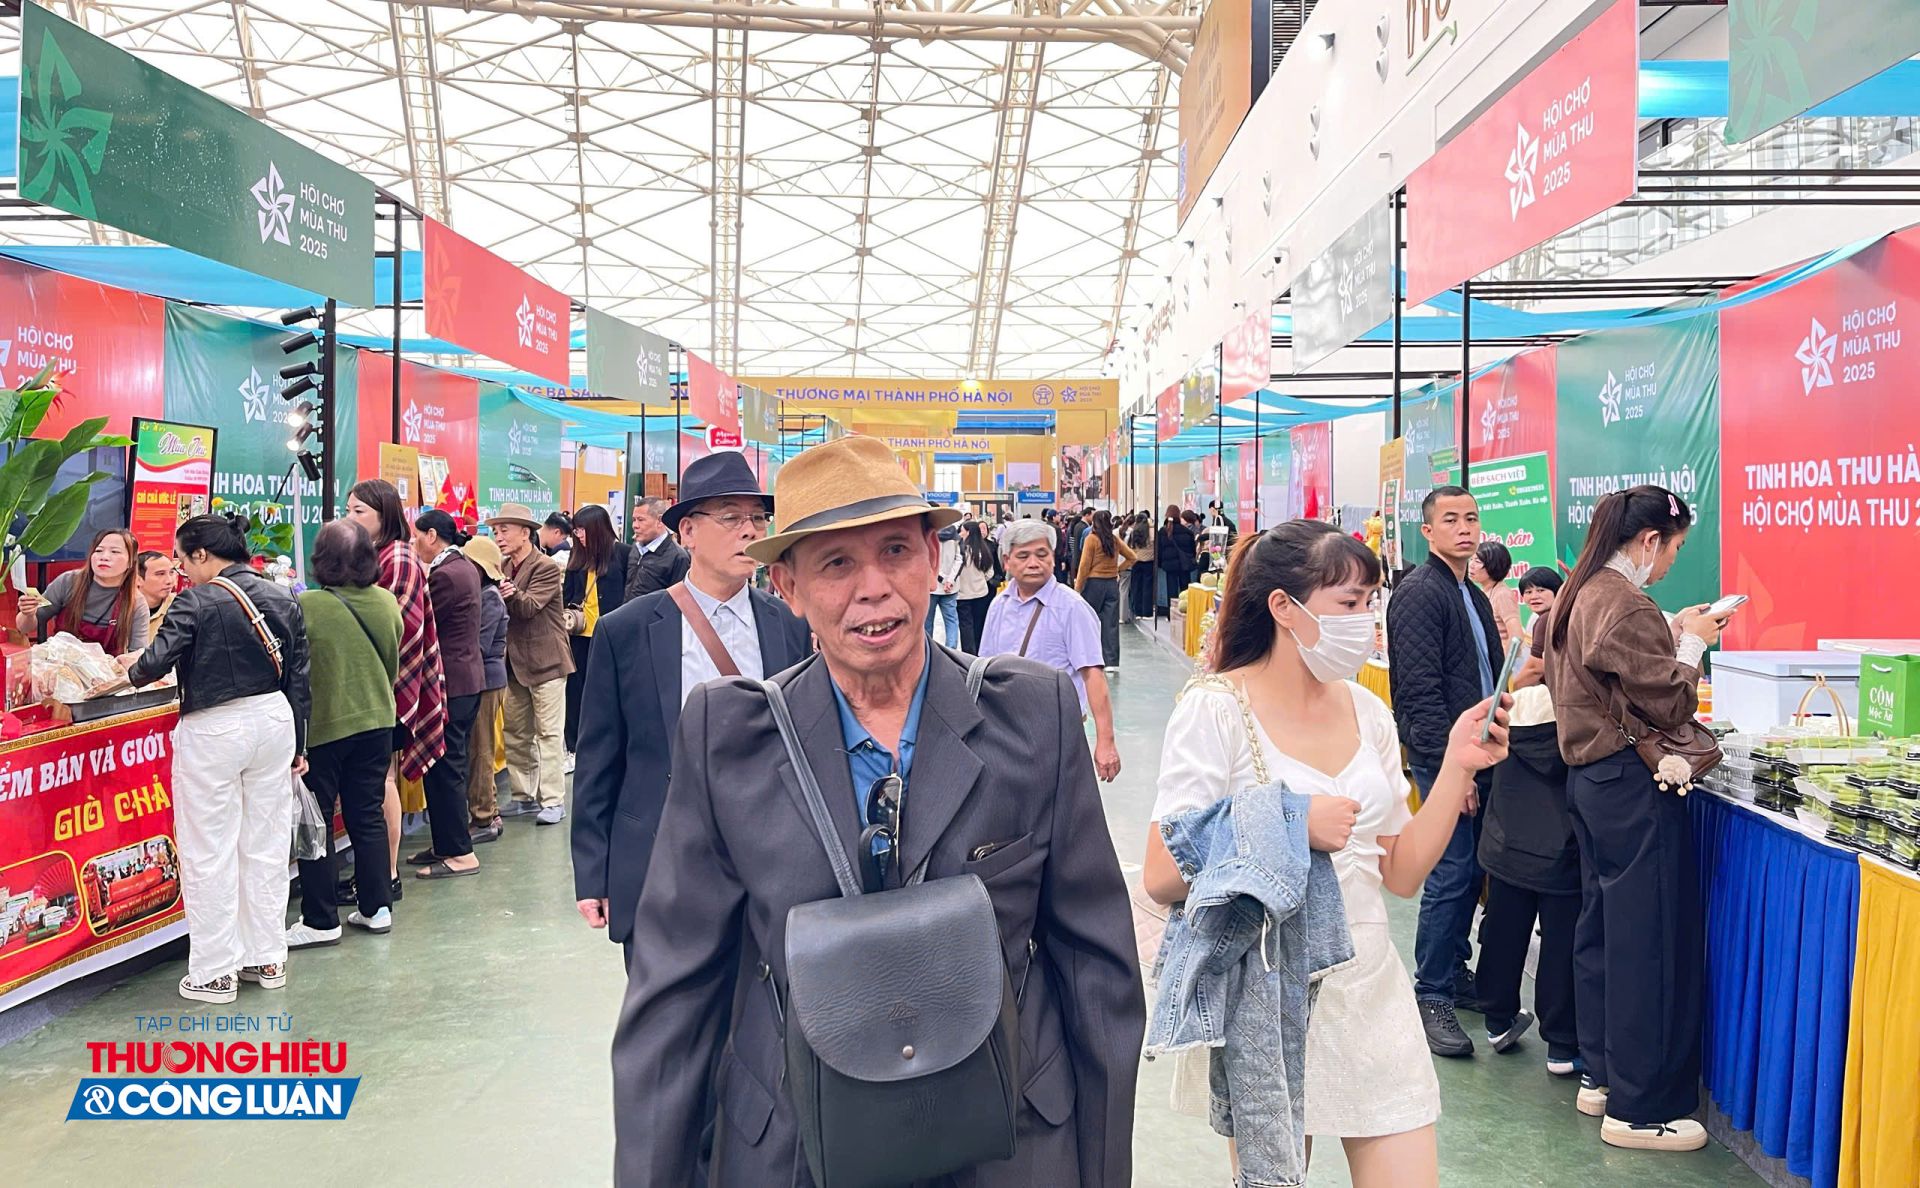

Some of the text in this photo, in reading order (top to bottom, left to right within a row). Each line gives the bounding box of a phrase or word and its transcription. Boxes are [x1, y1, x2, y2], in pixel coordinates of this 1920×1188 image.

[1543, 75, 1591, 131] HỘI CHỢ
[1543, 112, 1594, 163] MÙA THU
[1543, 161, 1571, 196] 2025
[300, 182, 345, 219] HỘI CHỢ
[300, 208, 347, 242] MÙA THU
[300, 235, 328, 259] 2025
[1842, 301, 1896, 333] HỘI CHỢ
[18, 325, 74, 353] HỘI CHỢ
[1843, 329, 1901, 357] MÙA THU
[17, 349, 47, 369] MÙA
[1625, 361, 1655, 383] HỘI CHỢ
[1843, 361, 1875, 383] 2025
[843, 389, 870, 404] MẠI
[875, 387, 925, 402] THÀNH
[928, 386, 960, 402] PHỐ
[963, 388, 983, 402] HÀ
[987, 388, 1013, 406] NỘI
[1642, 383, 1657, 397] THU
[1625, 405, 1643, 420] 2025
[1745, 444, 1920, 490] TINH HOA THU HÀ
[232, 473, 265, 495] HOA
[489, 487, 505, 502] TINH
[505, 488, 519, 502] HOA
[520, 489, 533, 503] THU
[1569, 476, 1593, 496] TINH
[1596, 475, 1619, 496] HOA
[1649, 465, 1668, 489] HÀ
[1671, 464, 1696, 500] NỘI
[1568, 500, 1585, 529] HỘI
[1743, 491, 1909, 533] HỘI CHỢ MÙA THU
[39, 752, 85, 792] BÁN
[90, 740, 116, 776] VÀ
[121, 729, 166, 767] GIỚI
[54, 774, 171, 841] GIÒ CHẢ
